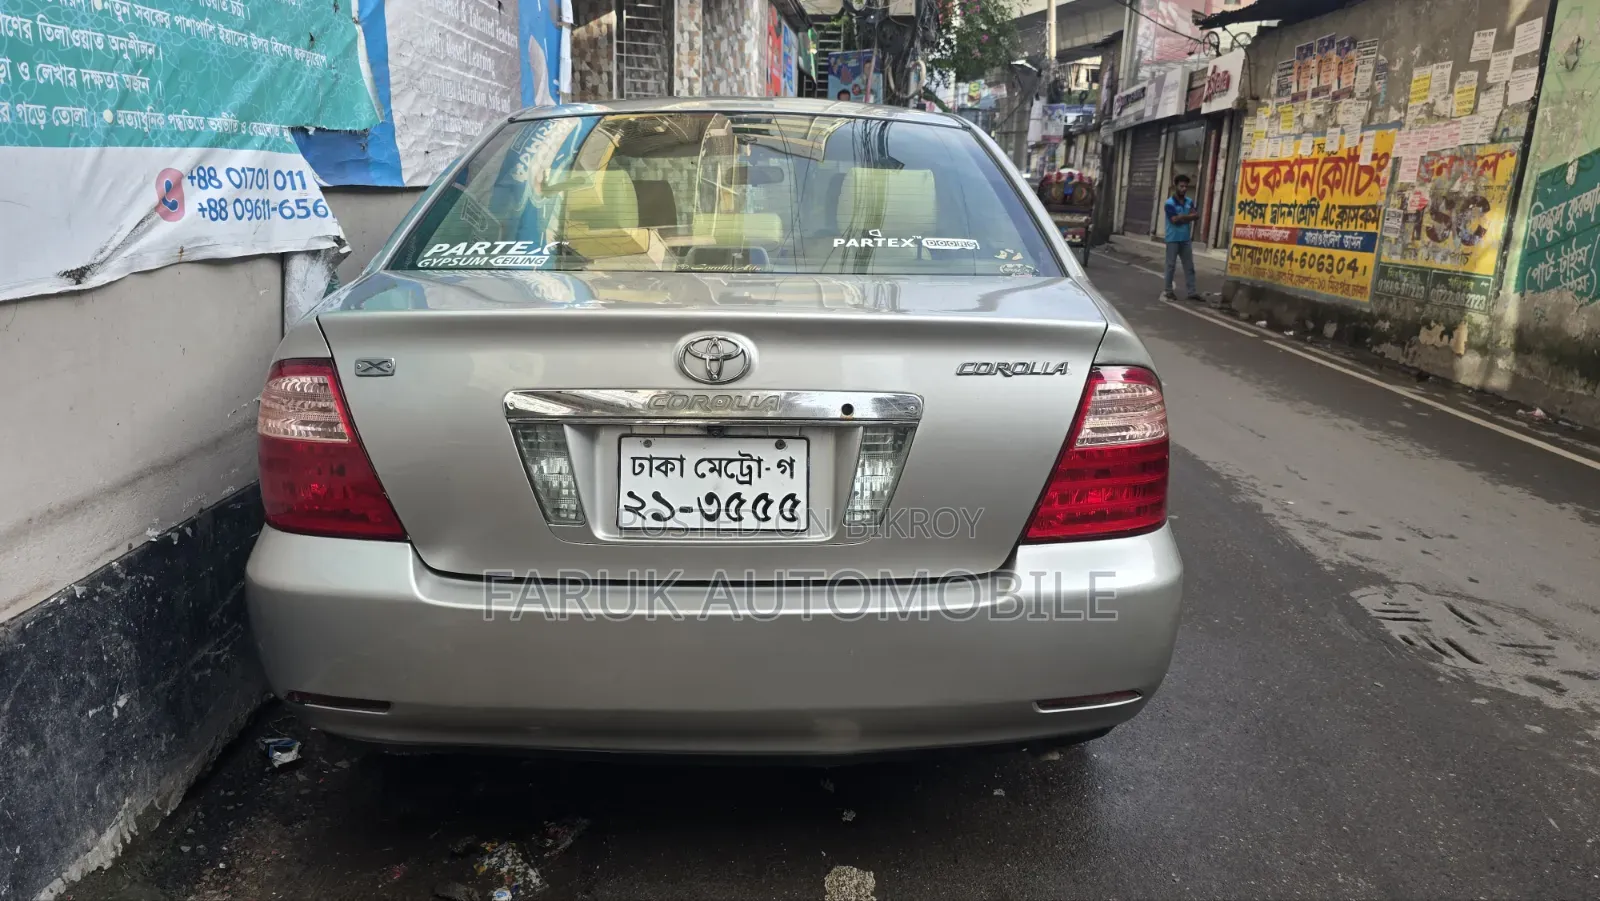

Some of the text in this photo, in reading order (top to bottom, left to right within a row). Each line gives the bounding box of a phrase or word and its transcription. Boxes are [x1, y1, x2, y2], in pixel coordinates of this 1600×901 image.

[17, 61, 30, 80] ও
[36, 63, 77, 88] লেখার
[80, 69, 119, 92] দক্ষতা
[121, 69, 150, 95] অর্জন
[16, 101, 47, 131] গড়ে
[187, 165, 307, 191] +88 01701 011
[197, 197, 336, 222] +88 09611-656
[1321, 203, 1337, 227] AC
[834, 238, 915, 247] PARTEX
[417, 256, 547, 268] GYPSUM CEILING
[956, 361, 1069, 377] COROLLA
[648, 394, 782, 412] COROLLA
[631, 454, 686, 479] ঢাকা
[624, 490, 802, 523] ২১-৩৫৫৫
